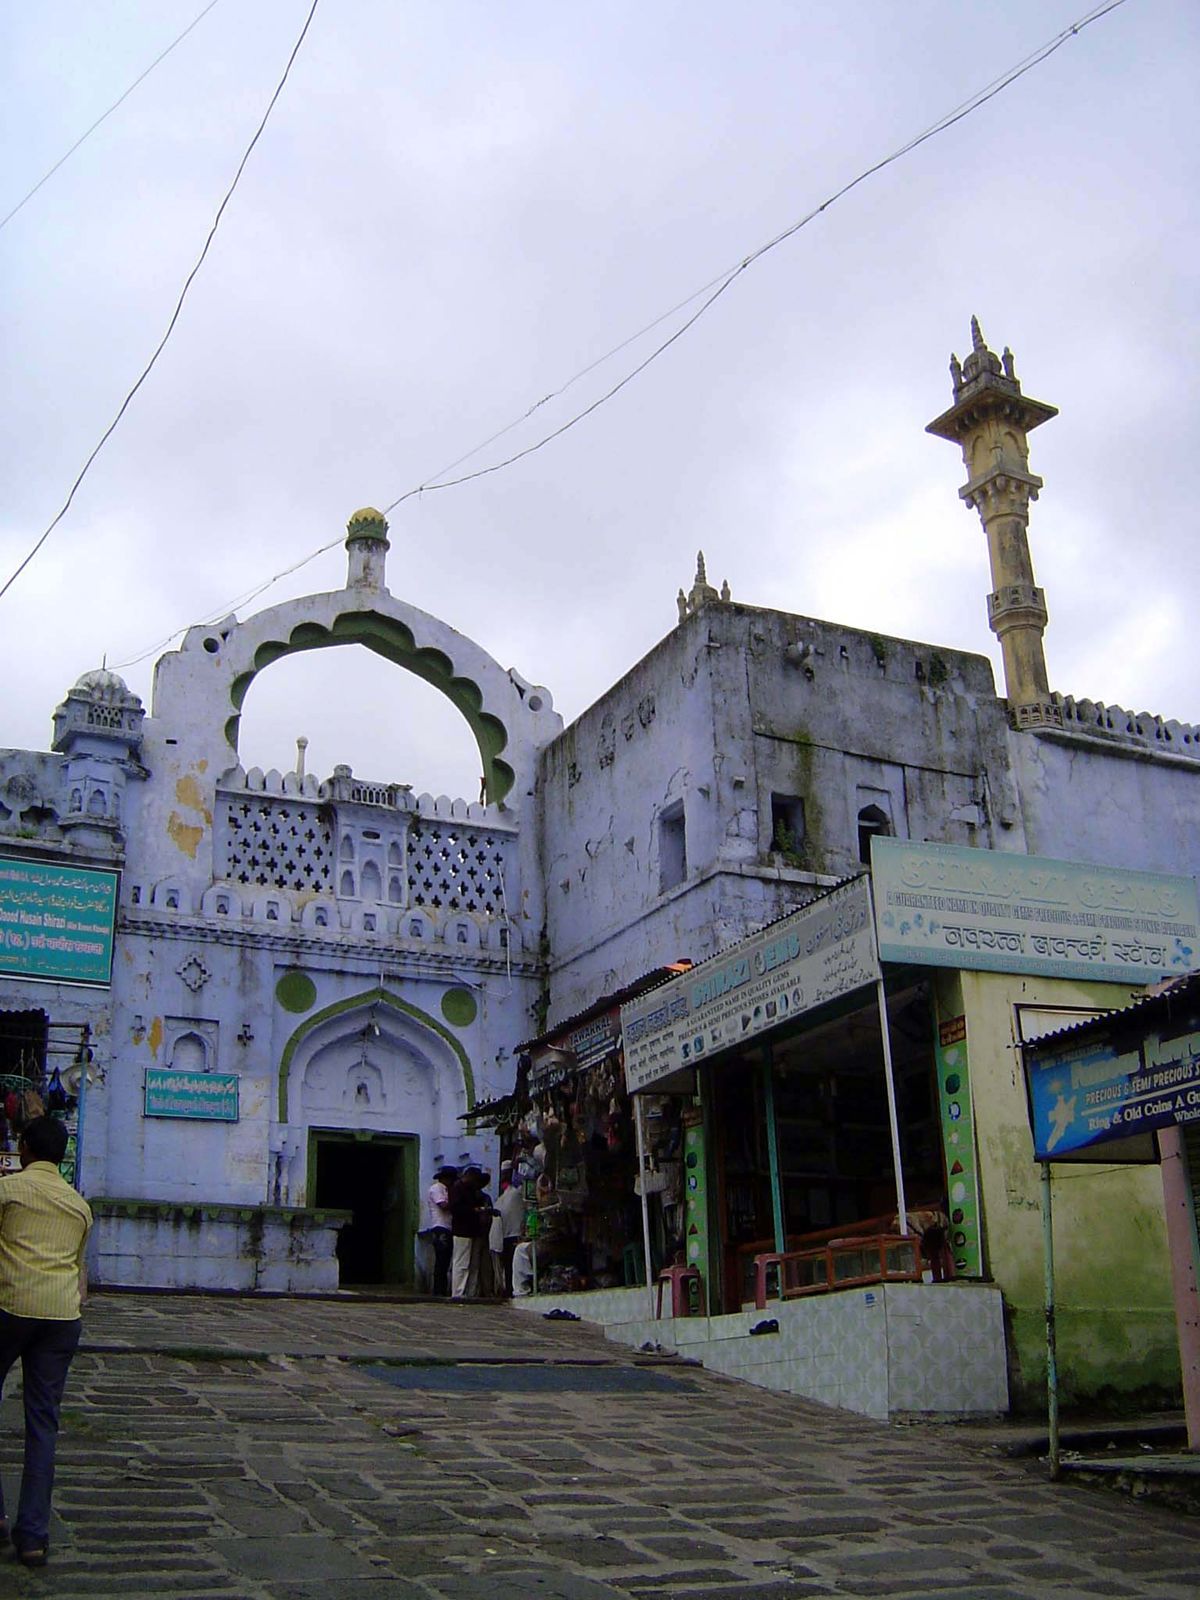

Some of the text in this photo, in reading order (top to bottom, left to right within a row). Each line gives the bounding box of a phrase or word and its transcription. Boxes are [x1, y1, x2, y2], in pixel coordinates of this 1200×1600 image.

[894, 892, 946, 911] GUARANTEED
[947, 897, 969, 913] NAME
[980, 901, 1011, 918] QUALITY
[900, 853, 1070, 905] SHIRAZI
[1076, 880, 1183, 918] GEMS
[690, 956, 752, 1010] SHIRAZI
[691, 1001, 724, 1026] GUARANTEED
[747, 979, 772, 999] QUALITY
[772, 970, 790, 984] GEMS
[770, 976, 802, 998] AVAILABLE
[1085, 1086, 1122, 1105] PRECIOUS
[1131, 1077, 1152, 1094] SEMI
[1153, 1066, 1193, 1087] PRECIOUS
[1088, 1117, 1111, 1131] Ring
[1112, 1113, 1122, 1125] &
[1123, 1109, 1142, 1122] Old
[1143, 1100, 1173, 1117] Coins
[1175, 1095, 1185, 1109] A
